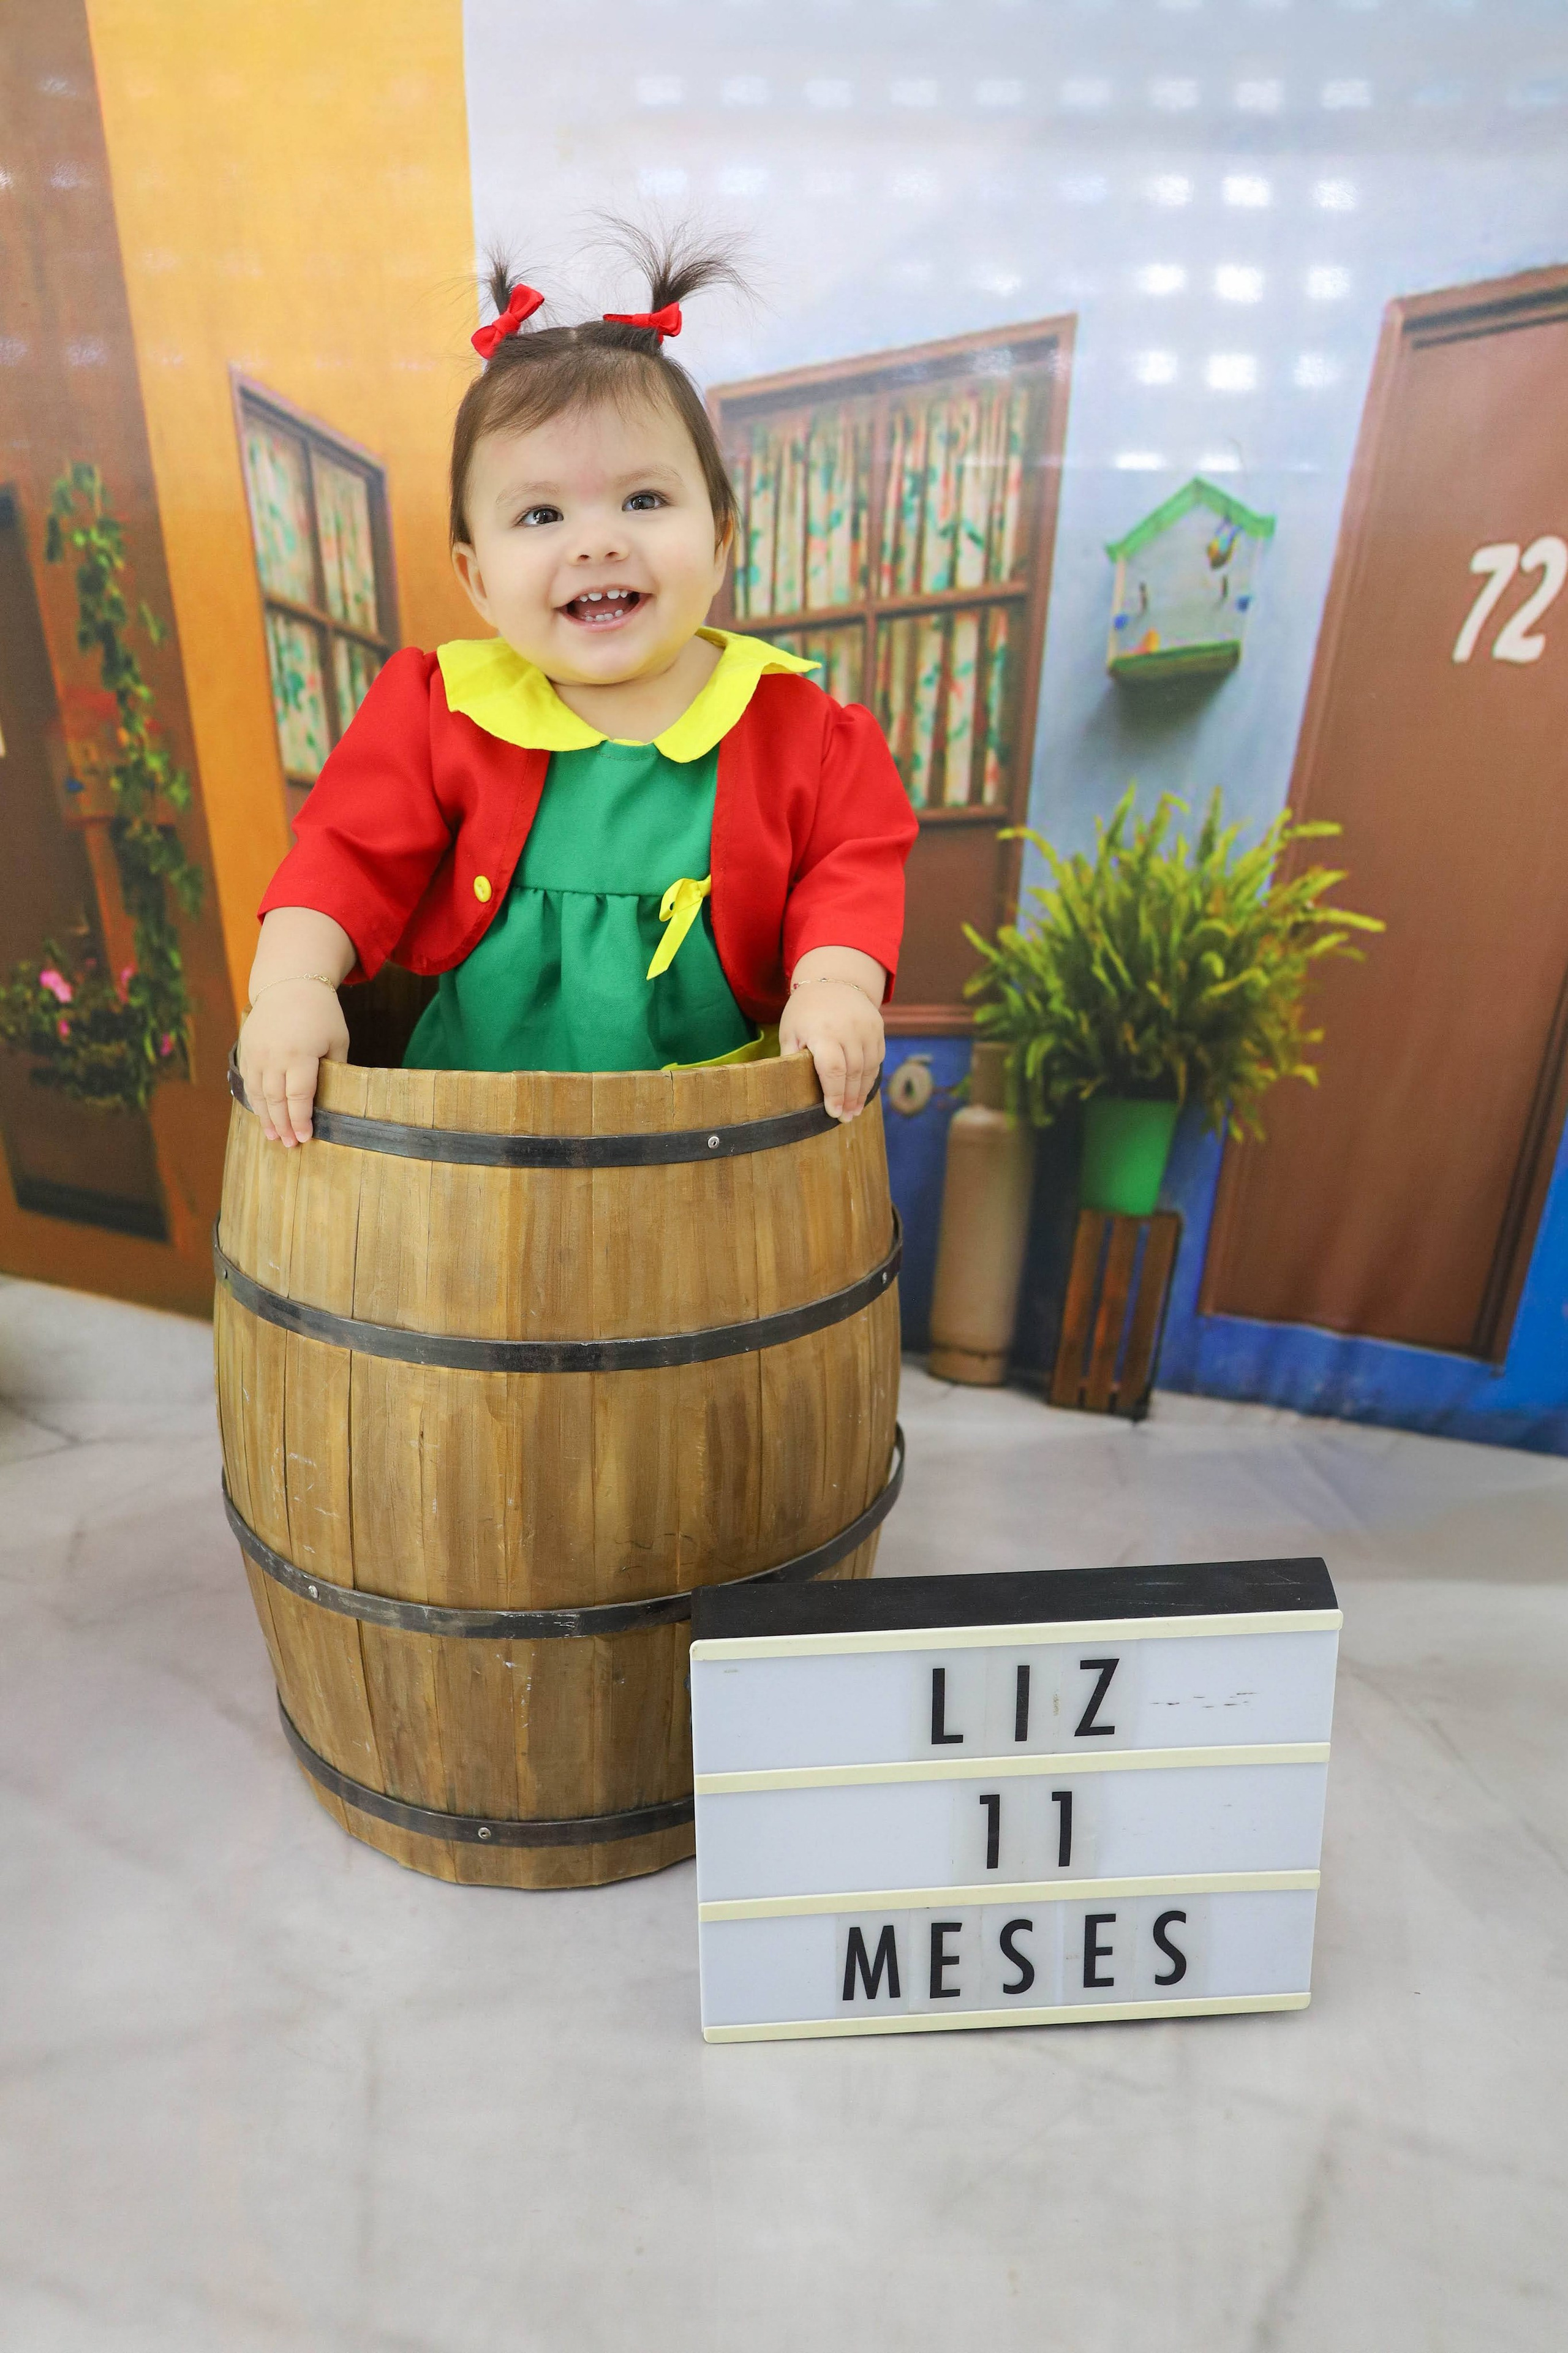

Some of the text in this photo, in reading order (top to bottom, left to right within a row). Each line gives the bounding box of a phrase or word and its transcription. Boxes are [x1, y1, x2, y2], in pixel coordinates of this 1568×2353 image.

[1452, 535, 1568, 663] 72
[931, 1658, 1120, 1745] LIZ
[979, 1791, 1072, 1870] 11
[842, 1910, 1187, 2001] MESES
